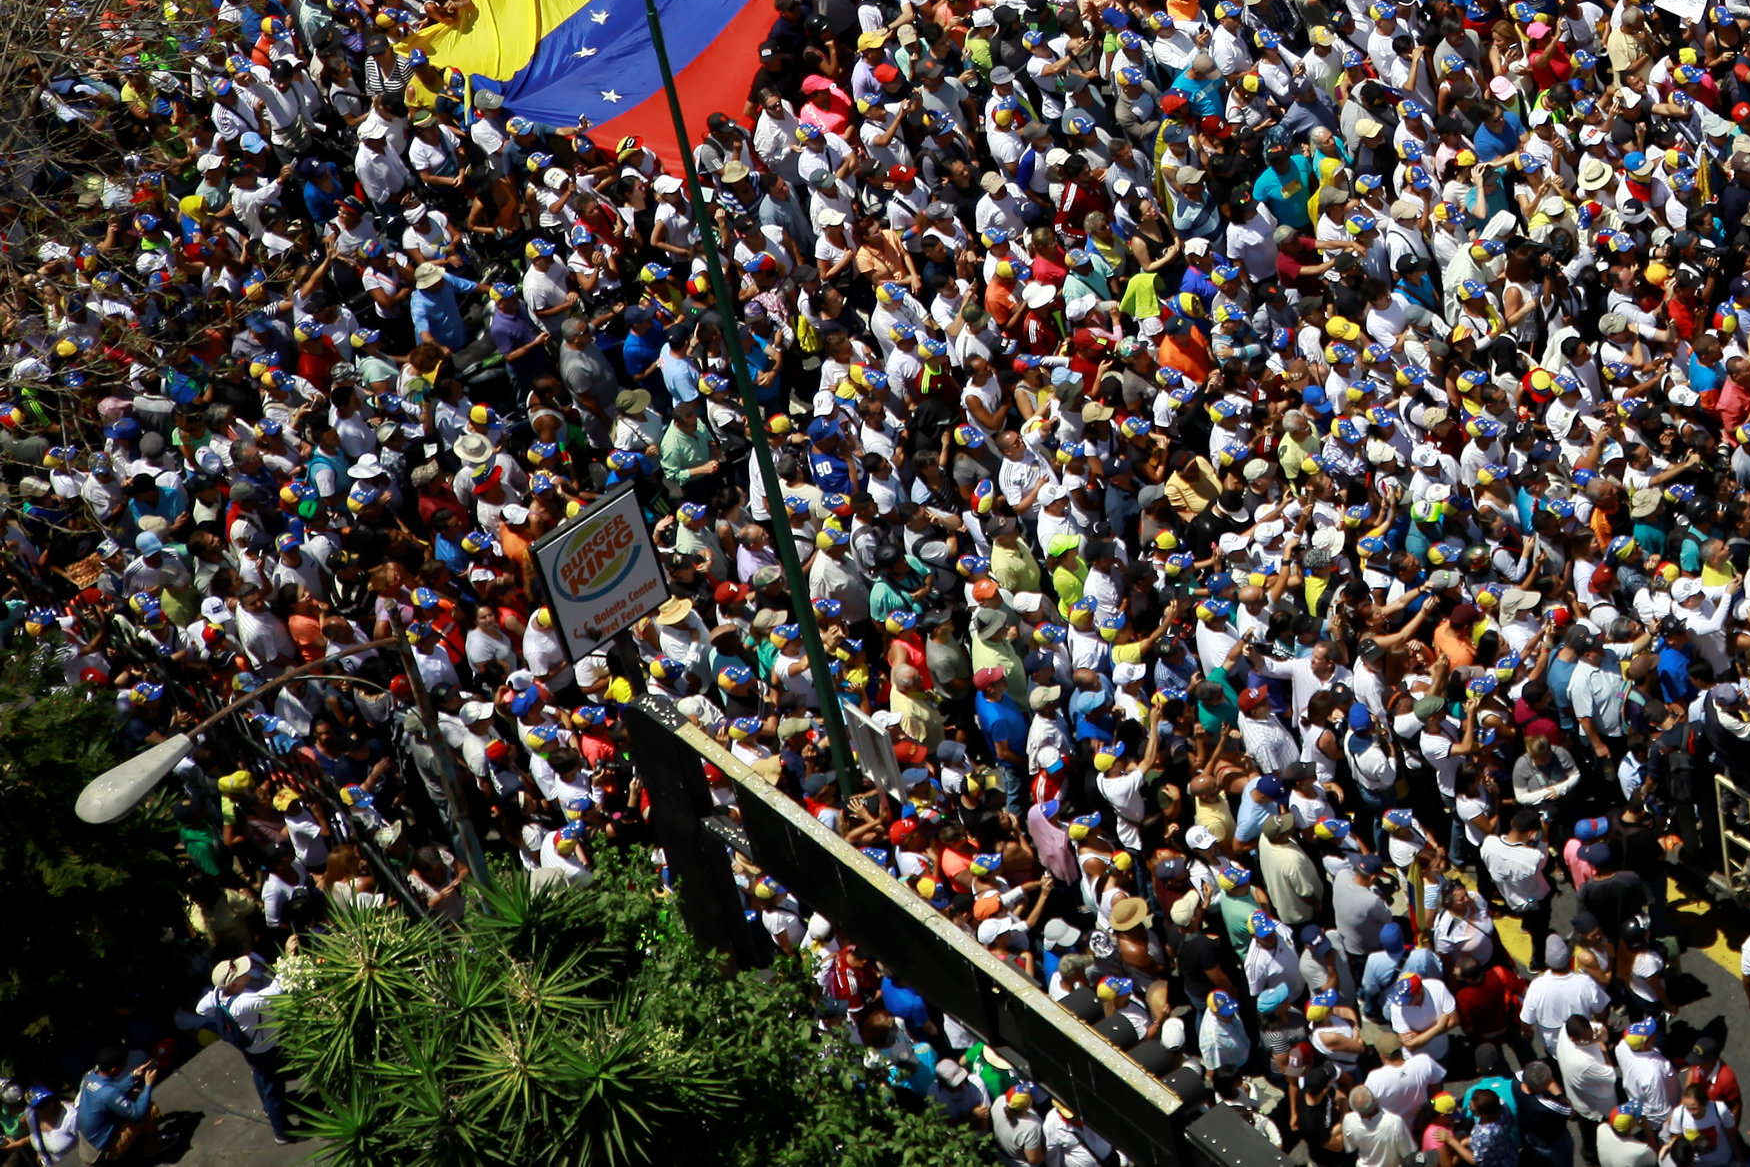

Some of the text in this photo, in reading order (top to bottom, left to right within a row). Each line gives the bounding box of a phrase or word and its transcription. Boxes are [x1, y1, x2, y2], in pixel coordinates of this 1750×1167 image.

[815, 461, 832, 477] 90
[560, 514, 626, 582] BURGER
[568, 524, 634, 599] KING
[628, 578, 657, 602] Center
[621, 603, 645, 623] Feria
